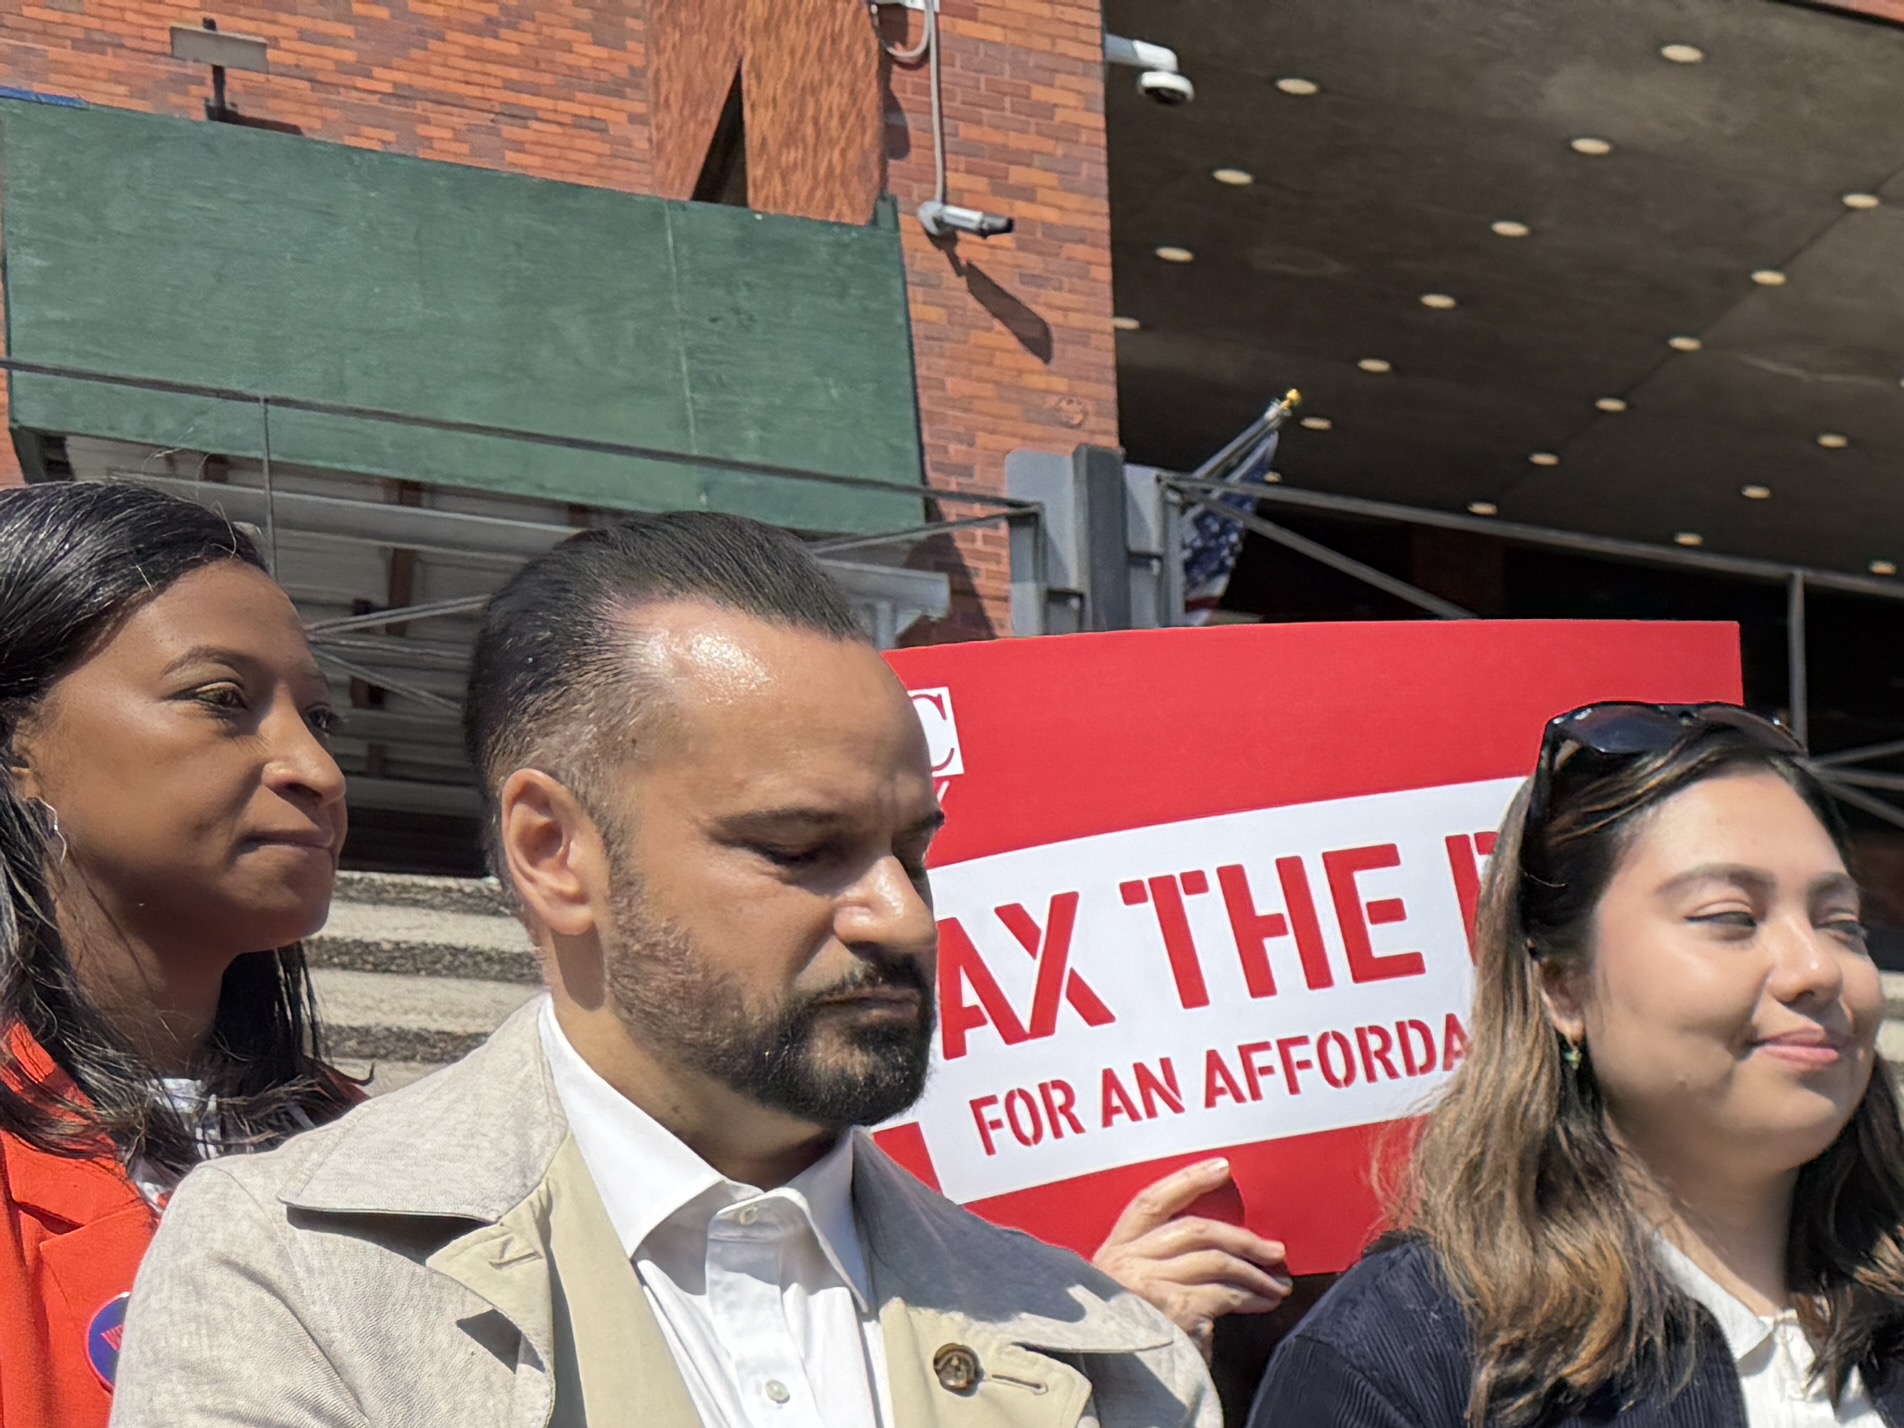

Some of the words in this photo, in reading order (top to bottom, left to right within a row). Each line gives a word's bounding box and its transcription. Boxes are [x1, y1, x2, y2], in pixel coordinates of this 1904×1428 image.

[1119, 843, 1426, 1010] THE
[970, 1079, 1086, 1155] FOR
[1101, 1056, 1185, 1128] AN
[1203, 1013, 1470, 1109] AFFORDA
